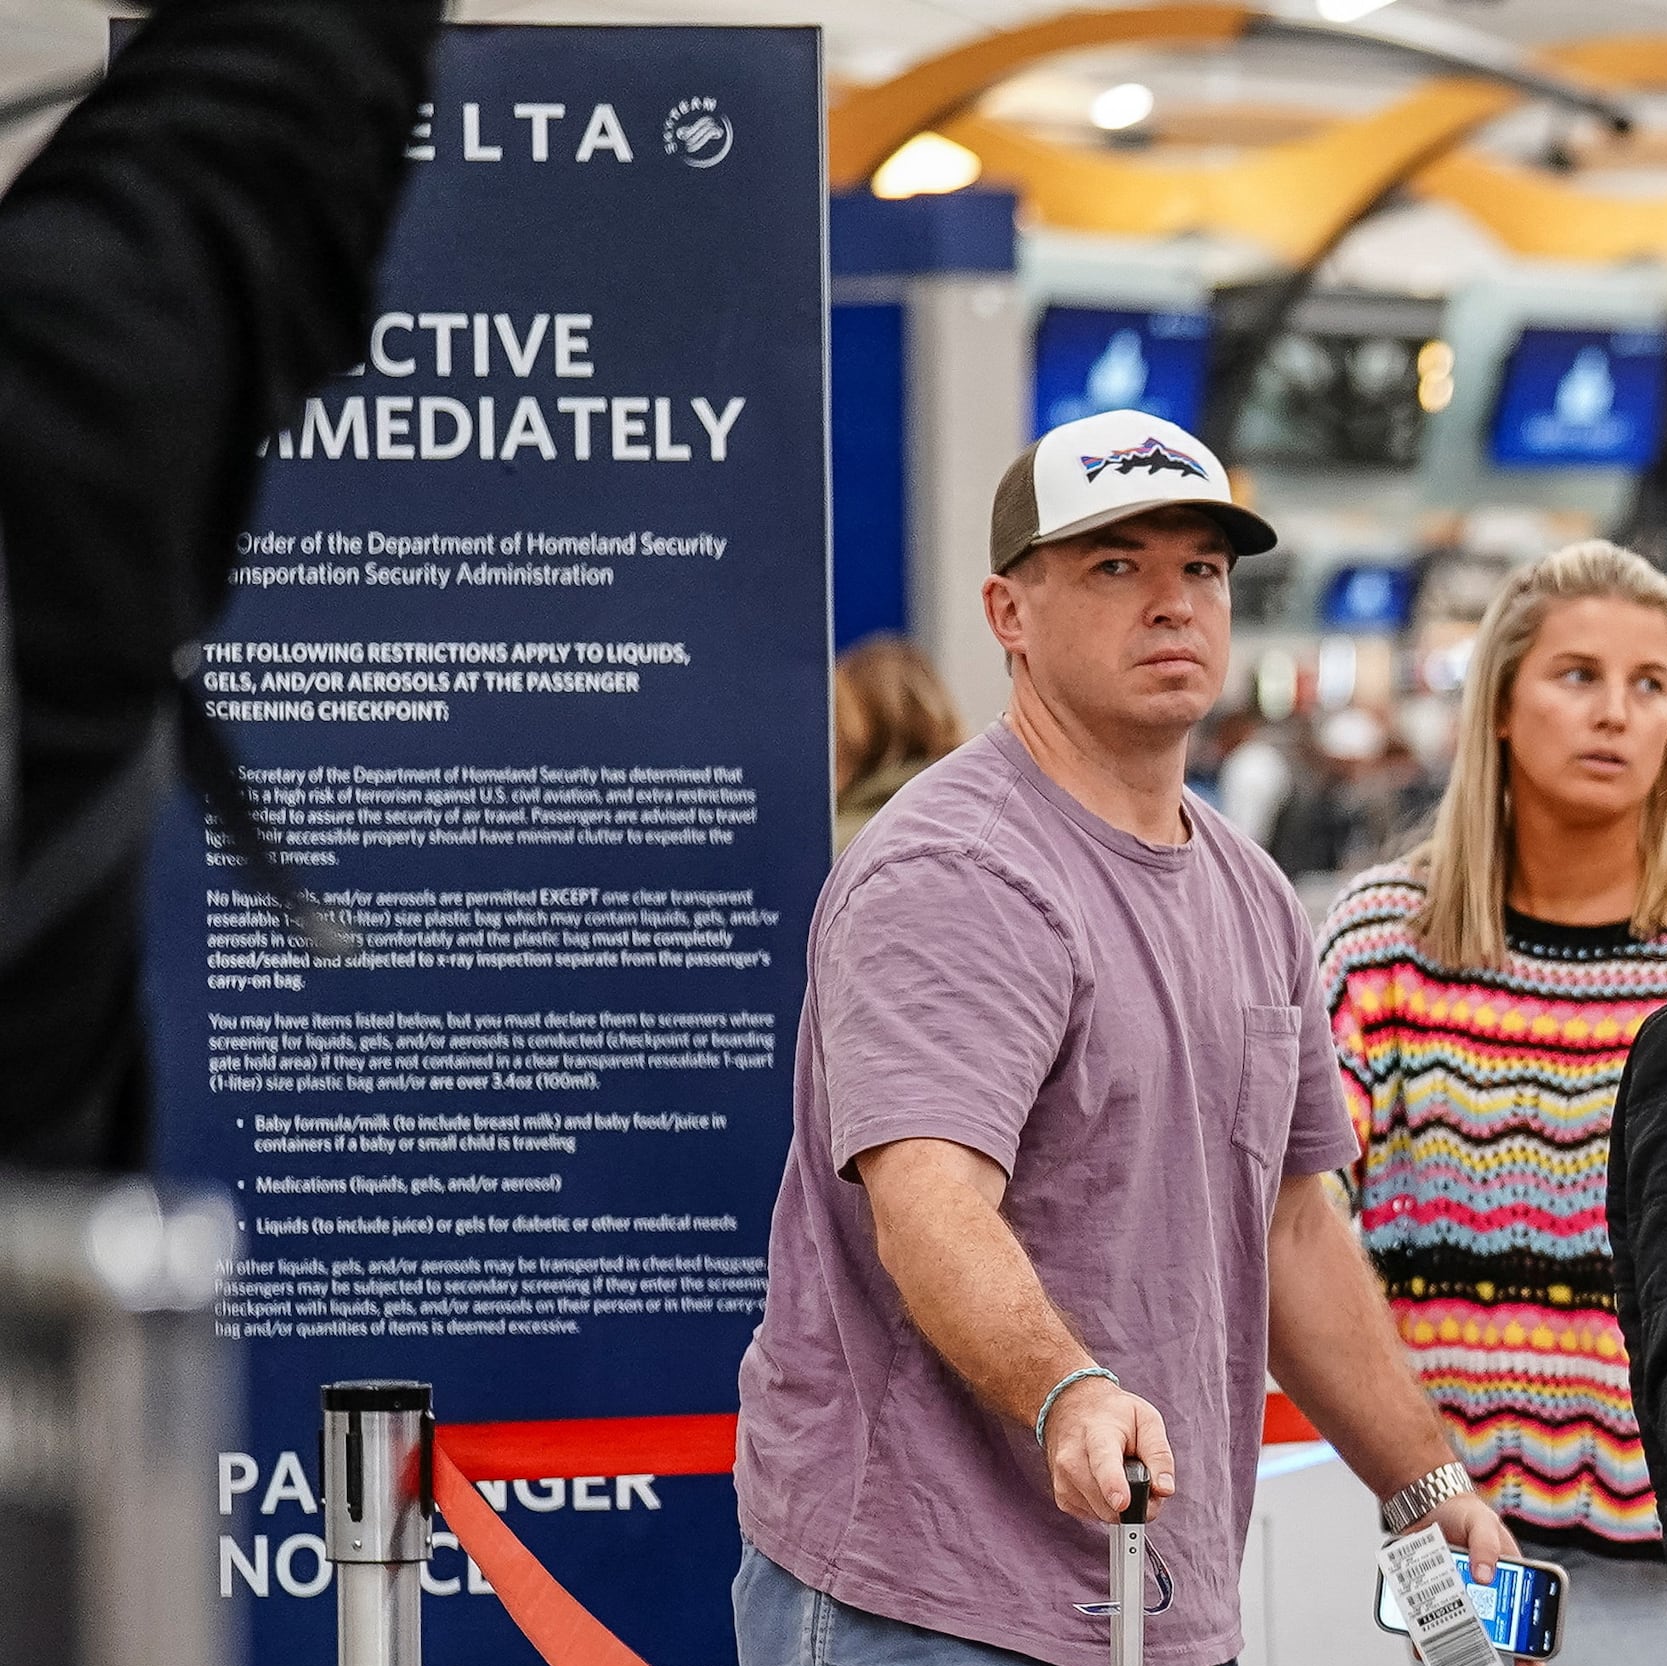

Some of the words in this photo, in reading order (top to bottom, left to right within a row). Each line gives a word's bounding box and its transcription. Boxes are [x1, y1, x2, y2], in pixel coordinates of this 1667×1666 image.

[404, 102, 634, 163] ELTA
[352, 313, 594, 377] CTIVE
[260, 396, 746, 461] MEDIATELY
[300, 532, 323, 554] of
[327, 532, 363, 554] the
[367, 532, 495, 558] Department
[499, 532, 522, 554] of
[526, 532, 636, 554] Homeland
[640, 532, 727, 558] Security
[228, 562, 361, 590] ansportation
[365, 562, 451, 590] Security
[455, 562, 613, 585] Administration
[203, 643, 242, 664] THE
[246, 643, 363, 664] FOLLOWING
[367, 643, 507, 664] RESTRICTIONS
[511, 643, 570, 664] APPLY
[574, 643, 602, 664] TO
[204, 672, 257, 695] GELS,
[261, 672, 343, 695] AND/OR
[347, 672, 450, 693] AEROSOLS
[454, 672, 479, 693] AT
[483, 672, 522, 693] THE
[526, 672, 639, 693] PASSENGER
[206, 701, 314, 722] SCREENING
